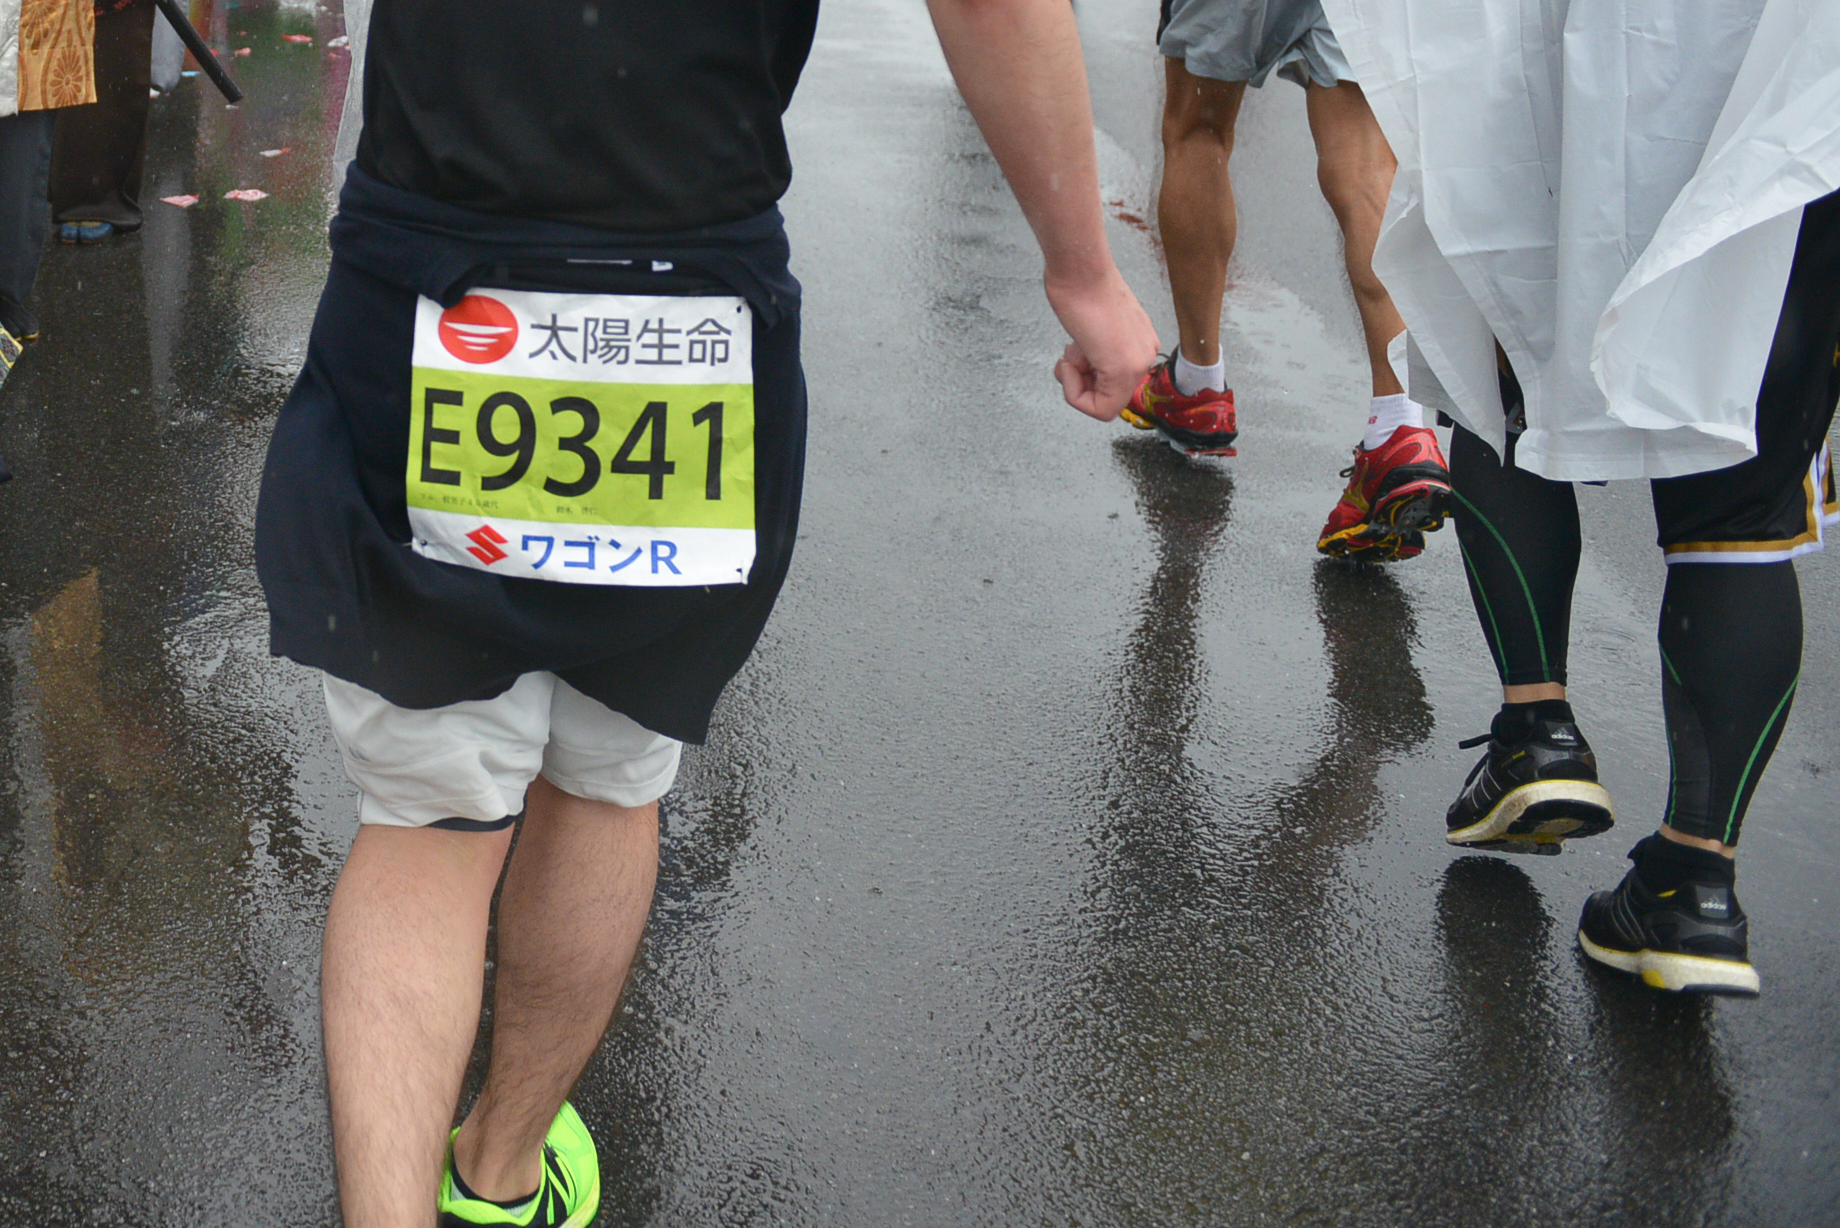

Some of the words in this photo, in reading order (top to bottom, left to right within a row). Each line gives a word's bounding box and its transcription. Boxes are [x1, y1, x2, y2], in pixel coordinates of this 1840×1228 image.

[528, 313, 733, 367] 太陽生命
[420, 387, 725, 501] E9341
[521, 534, 682, 576] ワゴンR
